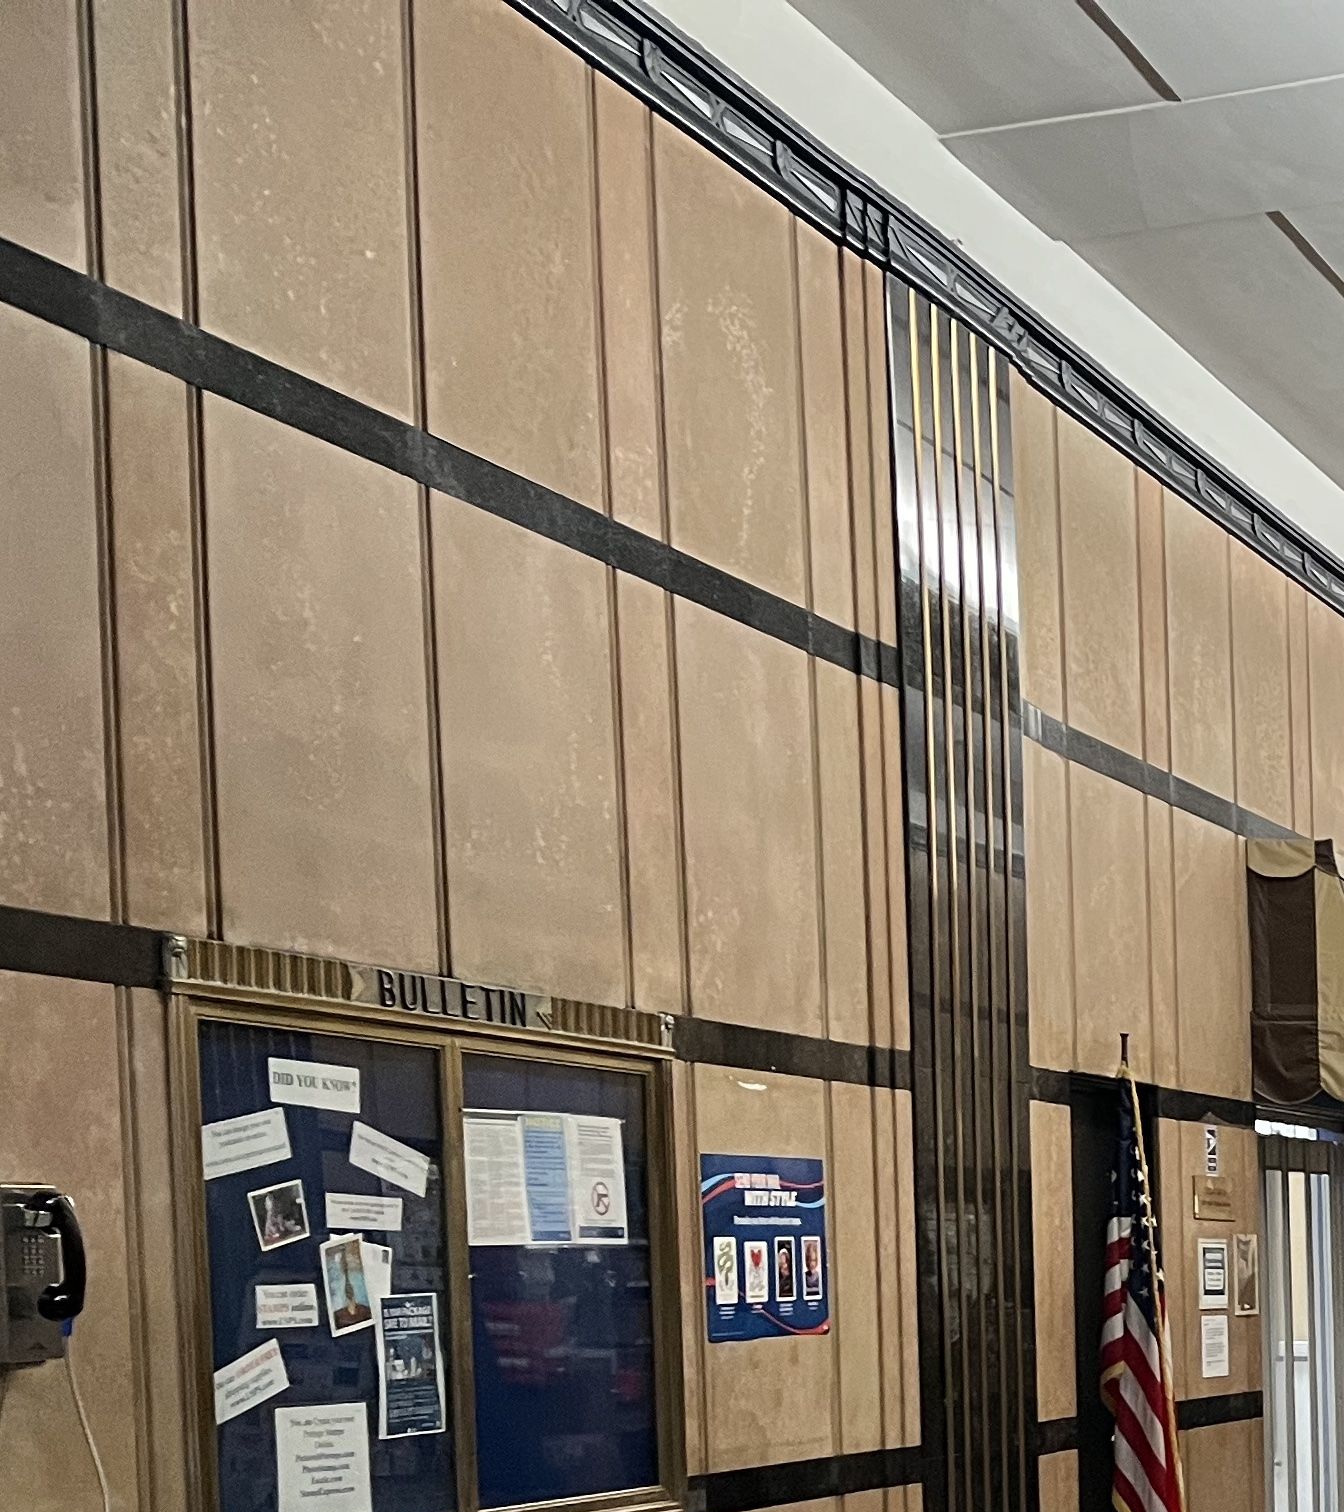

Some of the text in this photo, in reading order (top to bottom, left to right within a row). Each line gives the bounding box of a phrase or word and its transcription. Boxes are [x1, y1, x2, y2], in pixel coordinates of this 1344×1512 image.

[378, 969, 527, 1028] BULLETIN
[273, 1070, 294, 1086] DID
[769, 1190, 797, 1207] STYLE
